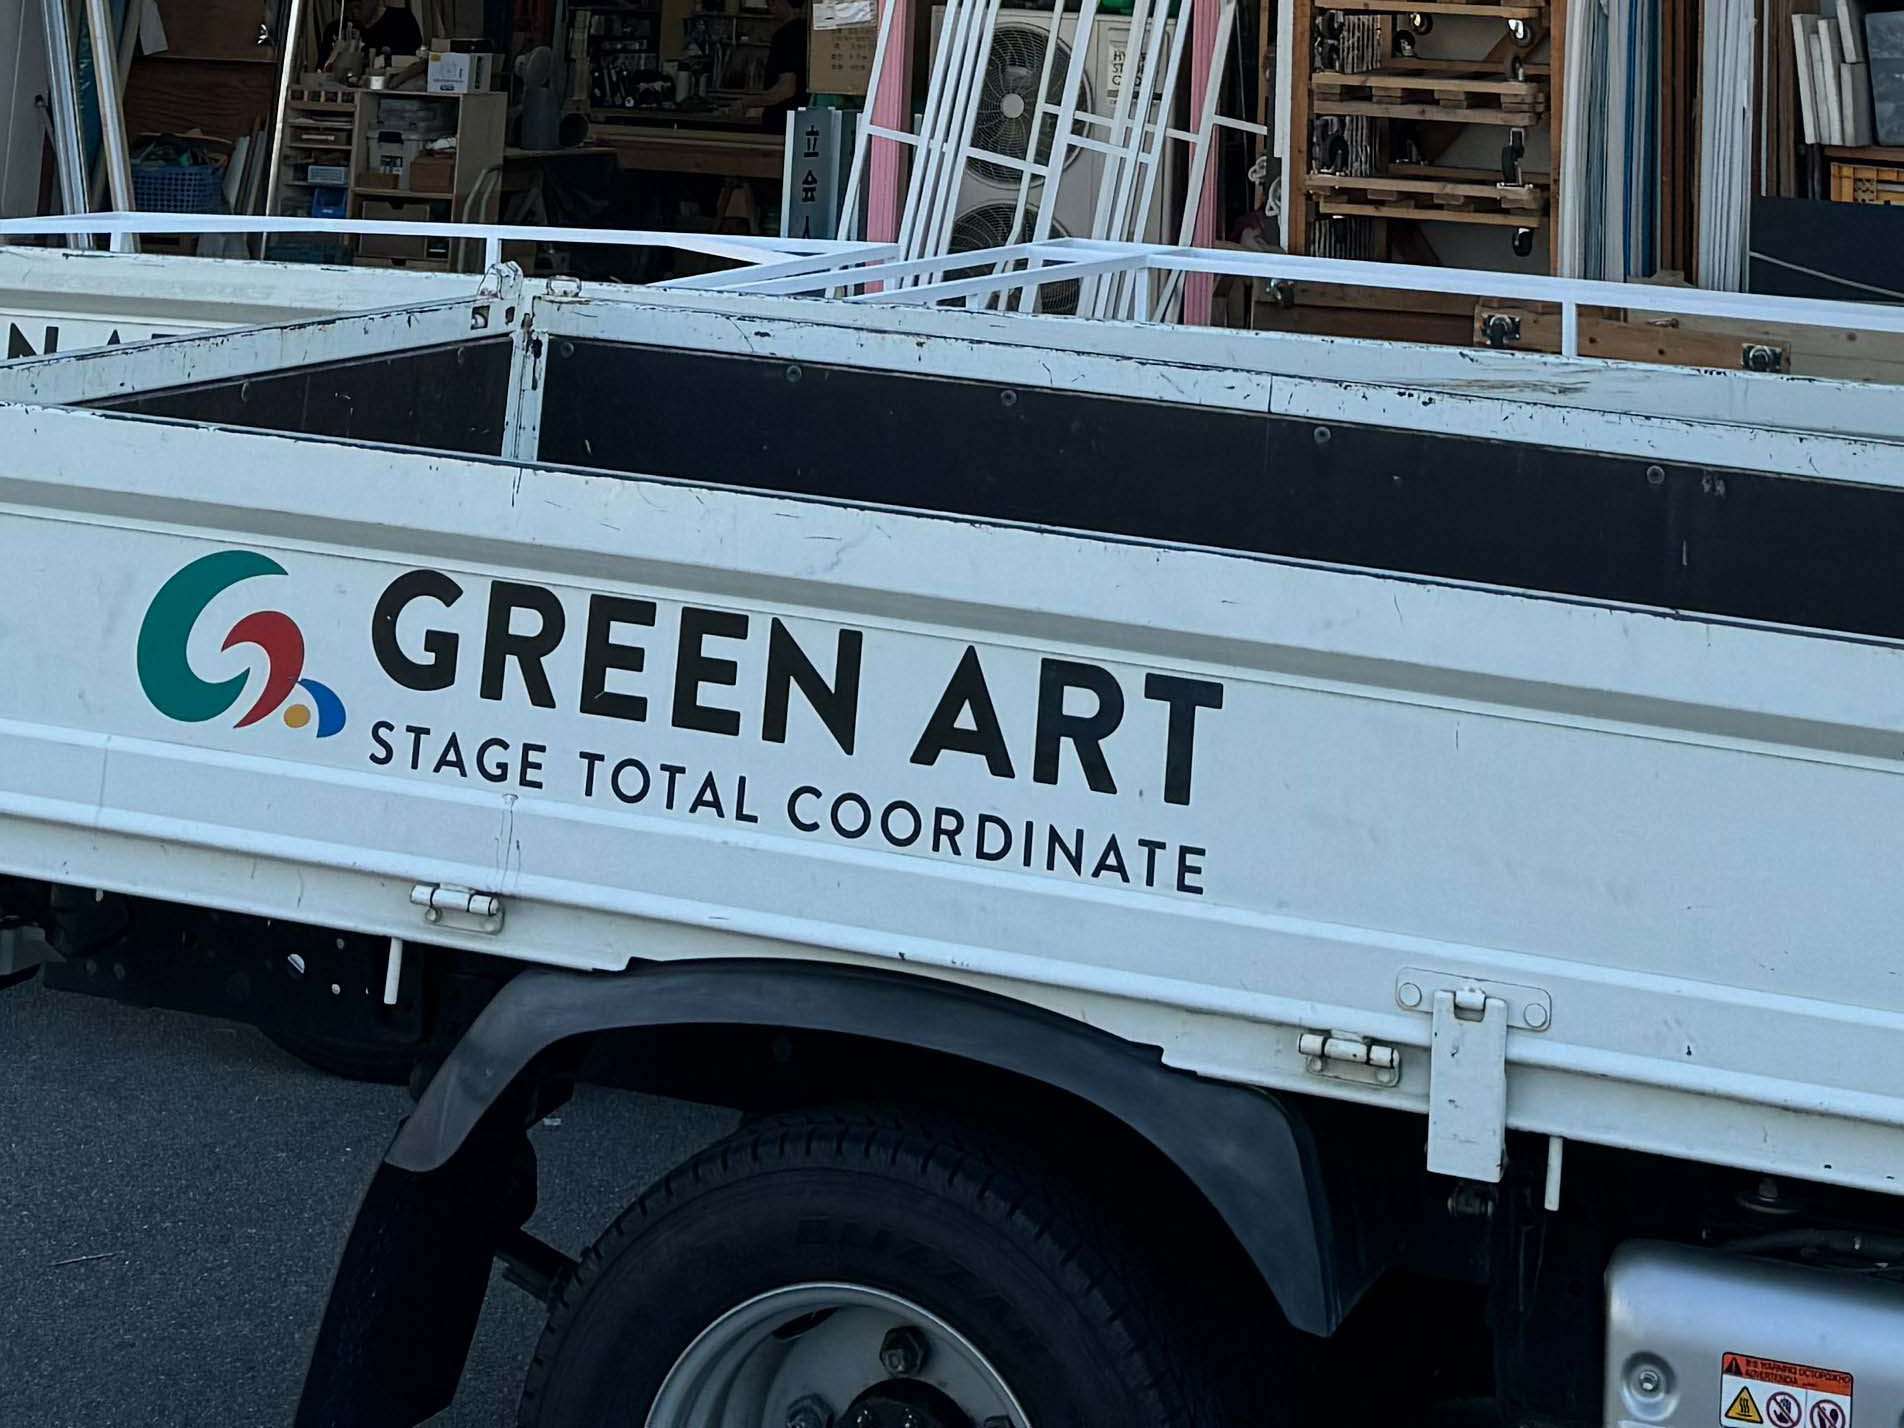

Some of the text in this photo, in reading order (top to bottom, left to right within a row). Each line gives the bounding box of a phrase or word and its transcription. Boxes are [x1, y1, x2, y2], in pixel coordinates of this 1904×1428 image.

[371, 569, 1224, 806] GREEN ART
[369, 720, 1206, 895] STAGE TOTAL COORDINATE
